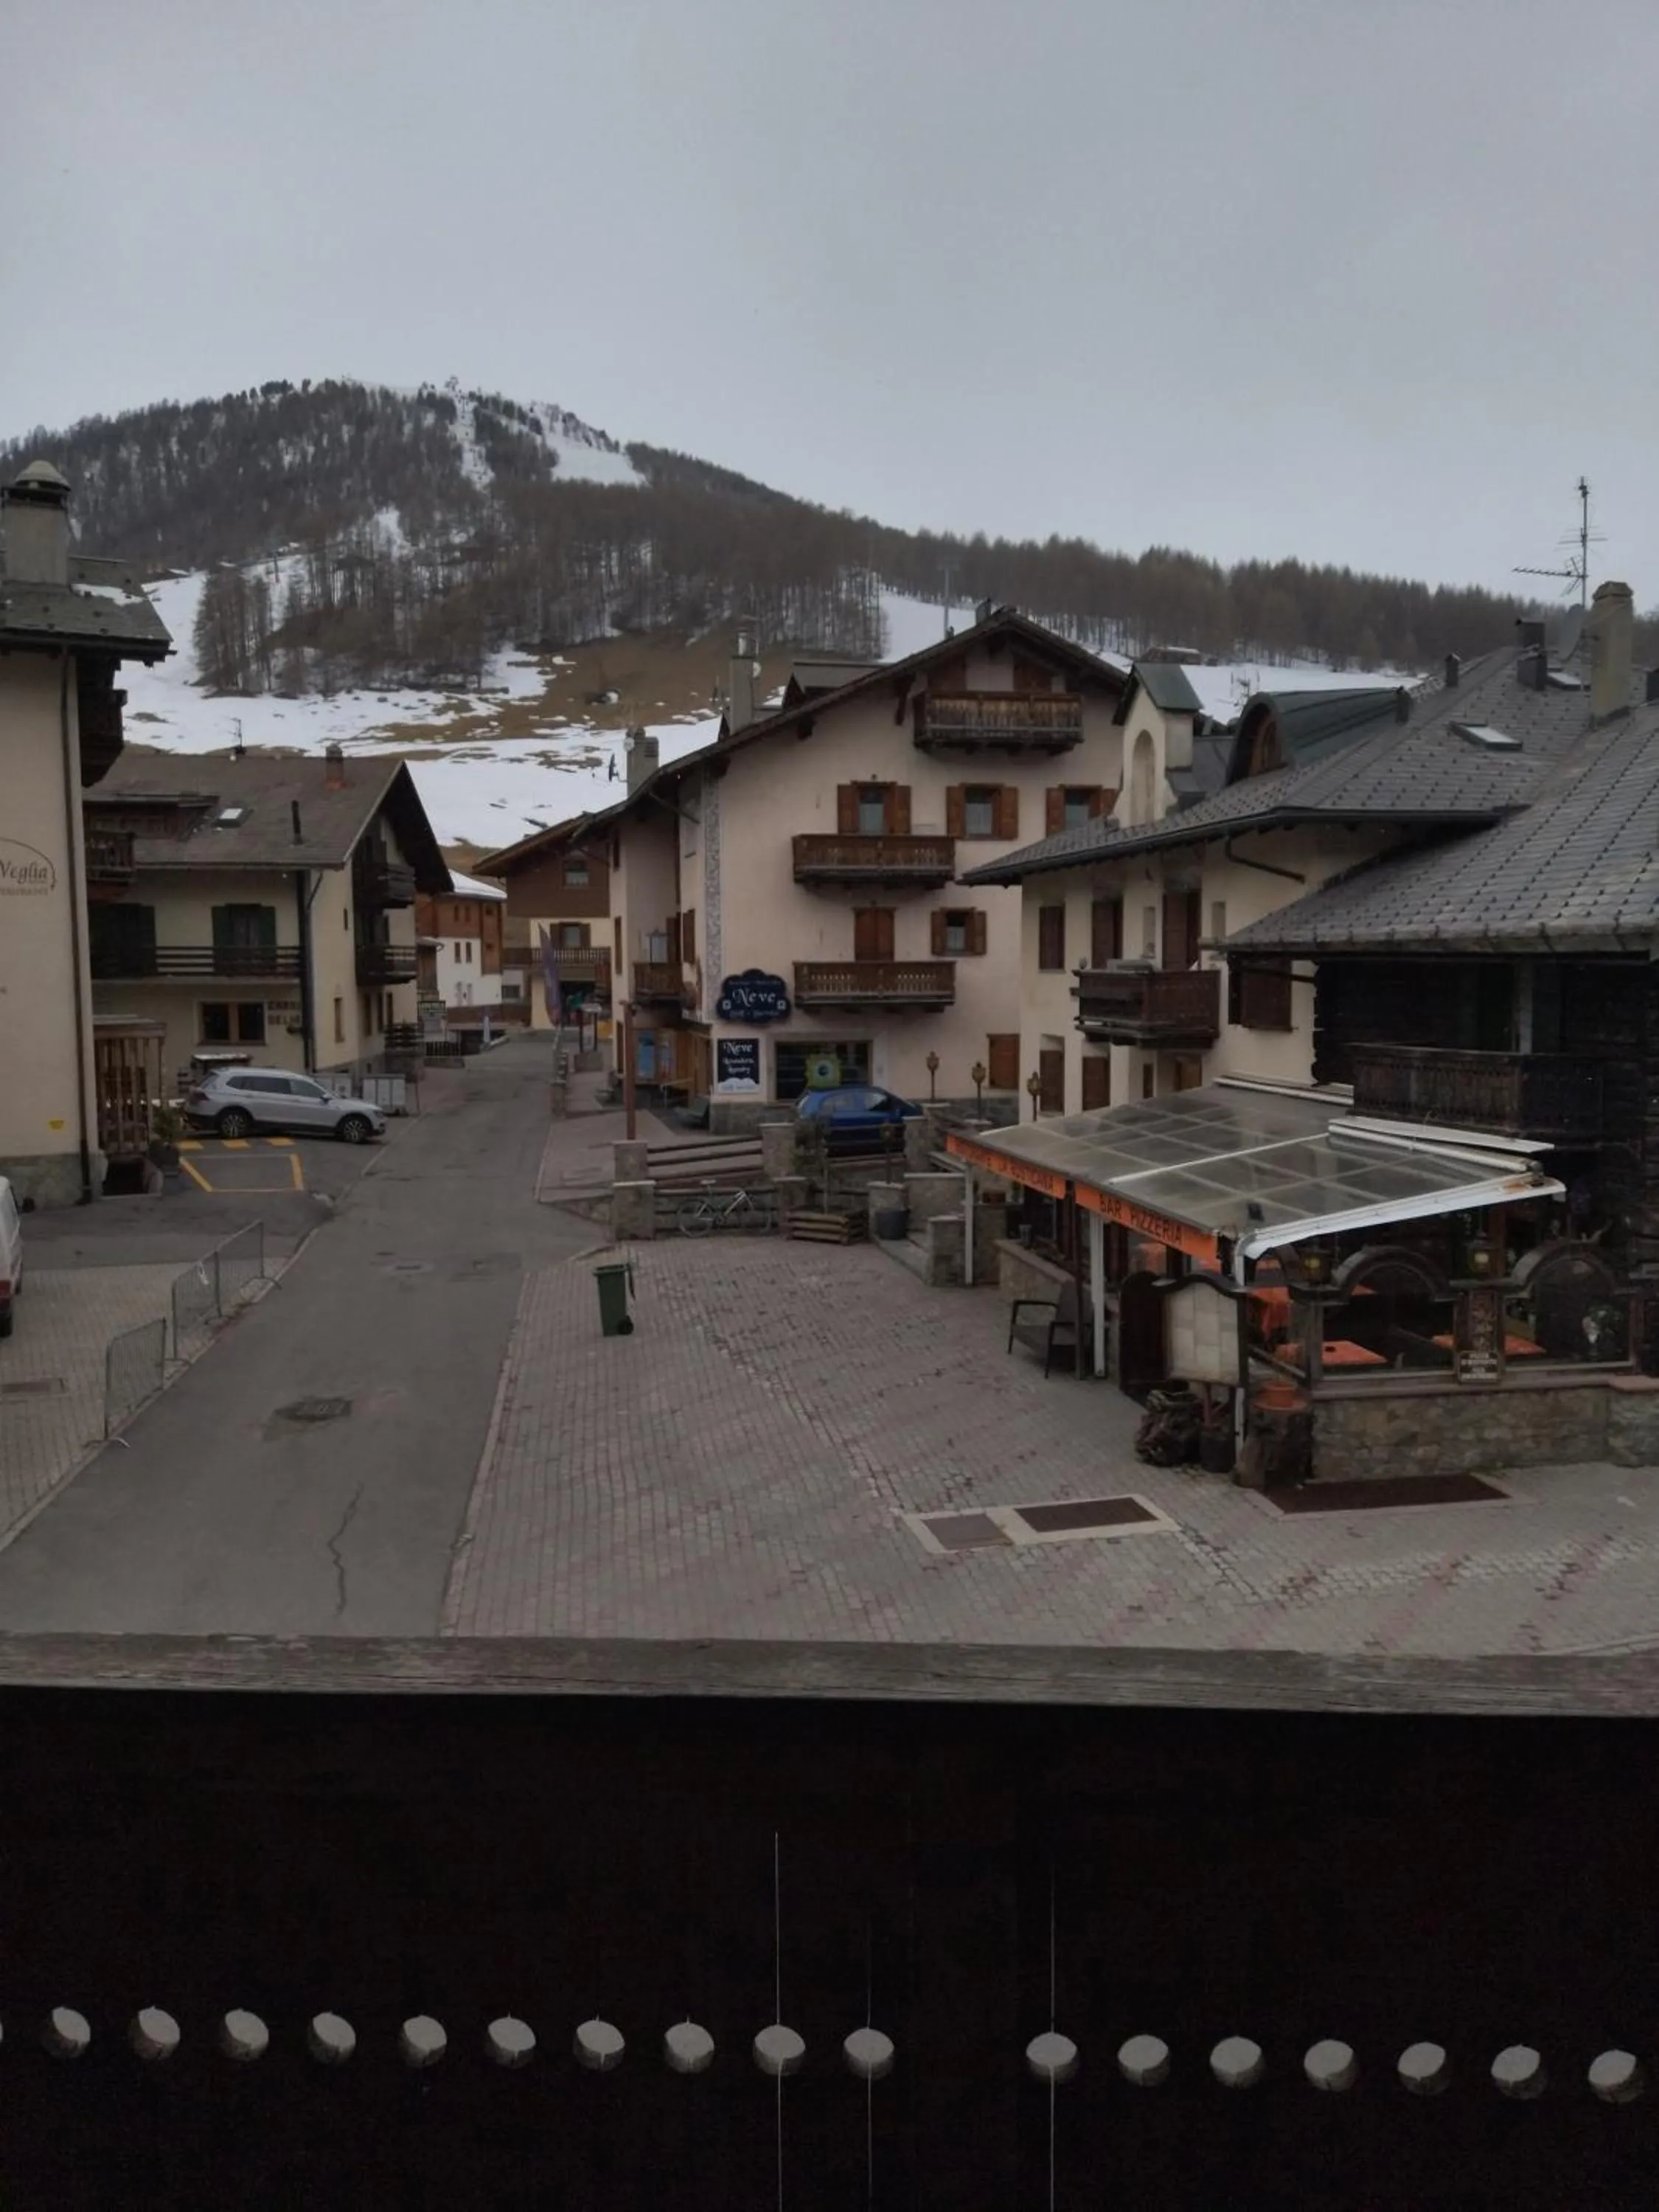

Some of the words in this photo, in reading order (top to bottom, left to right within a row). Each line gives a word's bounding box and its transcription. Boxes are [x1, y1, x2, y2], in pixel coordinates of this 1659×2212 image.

[731, 987, 776, 1007] Neve
[723, 1041, 754, 1055] Neve
[1099, 1192, 1122, 1219] BAR
[1130, 1204, 1183, 1243] PIZZERIA
